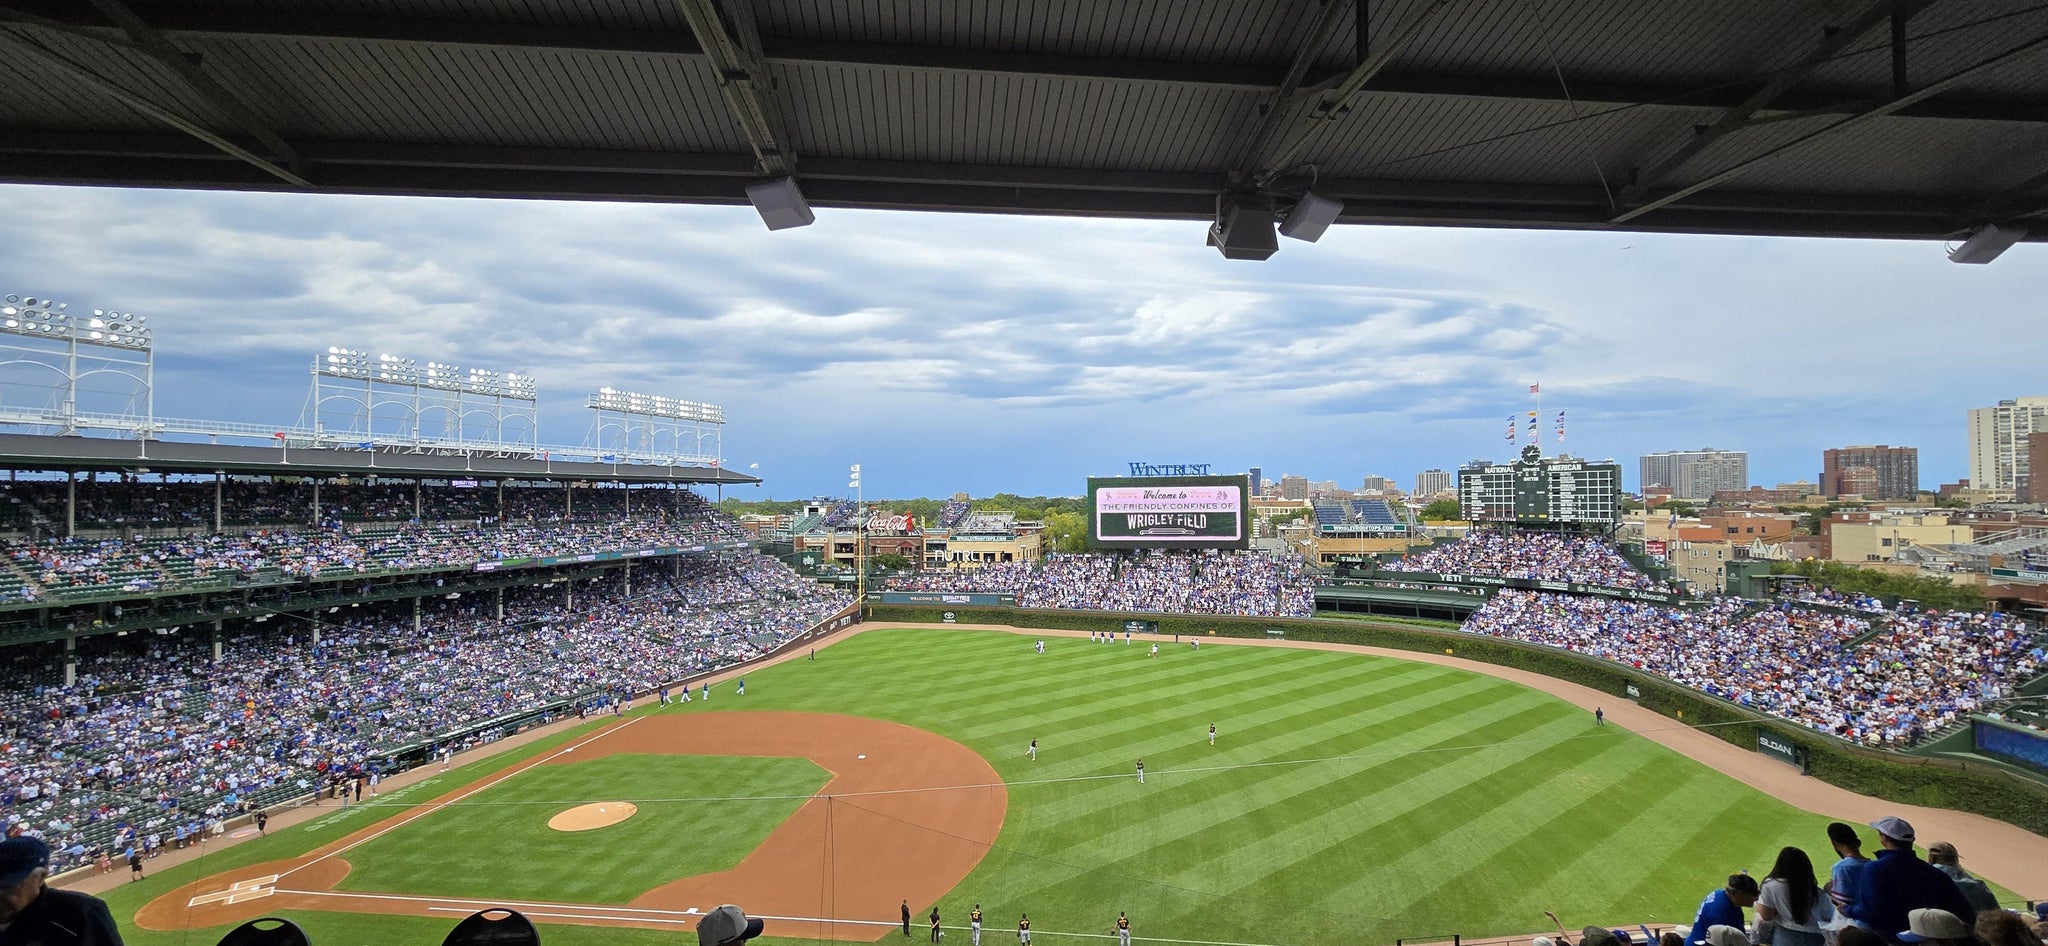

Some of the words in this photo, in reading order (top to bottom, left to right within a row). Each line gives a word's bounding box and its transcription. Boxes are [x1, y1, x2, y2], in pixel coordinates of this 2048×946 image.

[1128, 462, 1211, 476] WINTRUST
[1484, 466, 1516, 474] NATIONAL
[1143, 489, 1178, 500] Welcome
[1179, 491, 1187, 500] to
[1127, 514, 1174, 529] WRIGLEY
[1177, 514, 1207, 529] FIELD
[1439, 574, 1462, 582] YETI
[1474, 576, 1506, 585] tastytrade
[1588, 586, 1622, 596] Budweiser
[1638, 591, 1668, 602] Advocate
[1759, 736, 1792, 756] SLOAN
